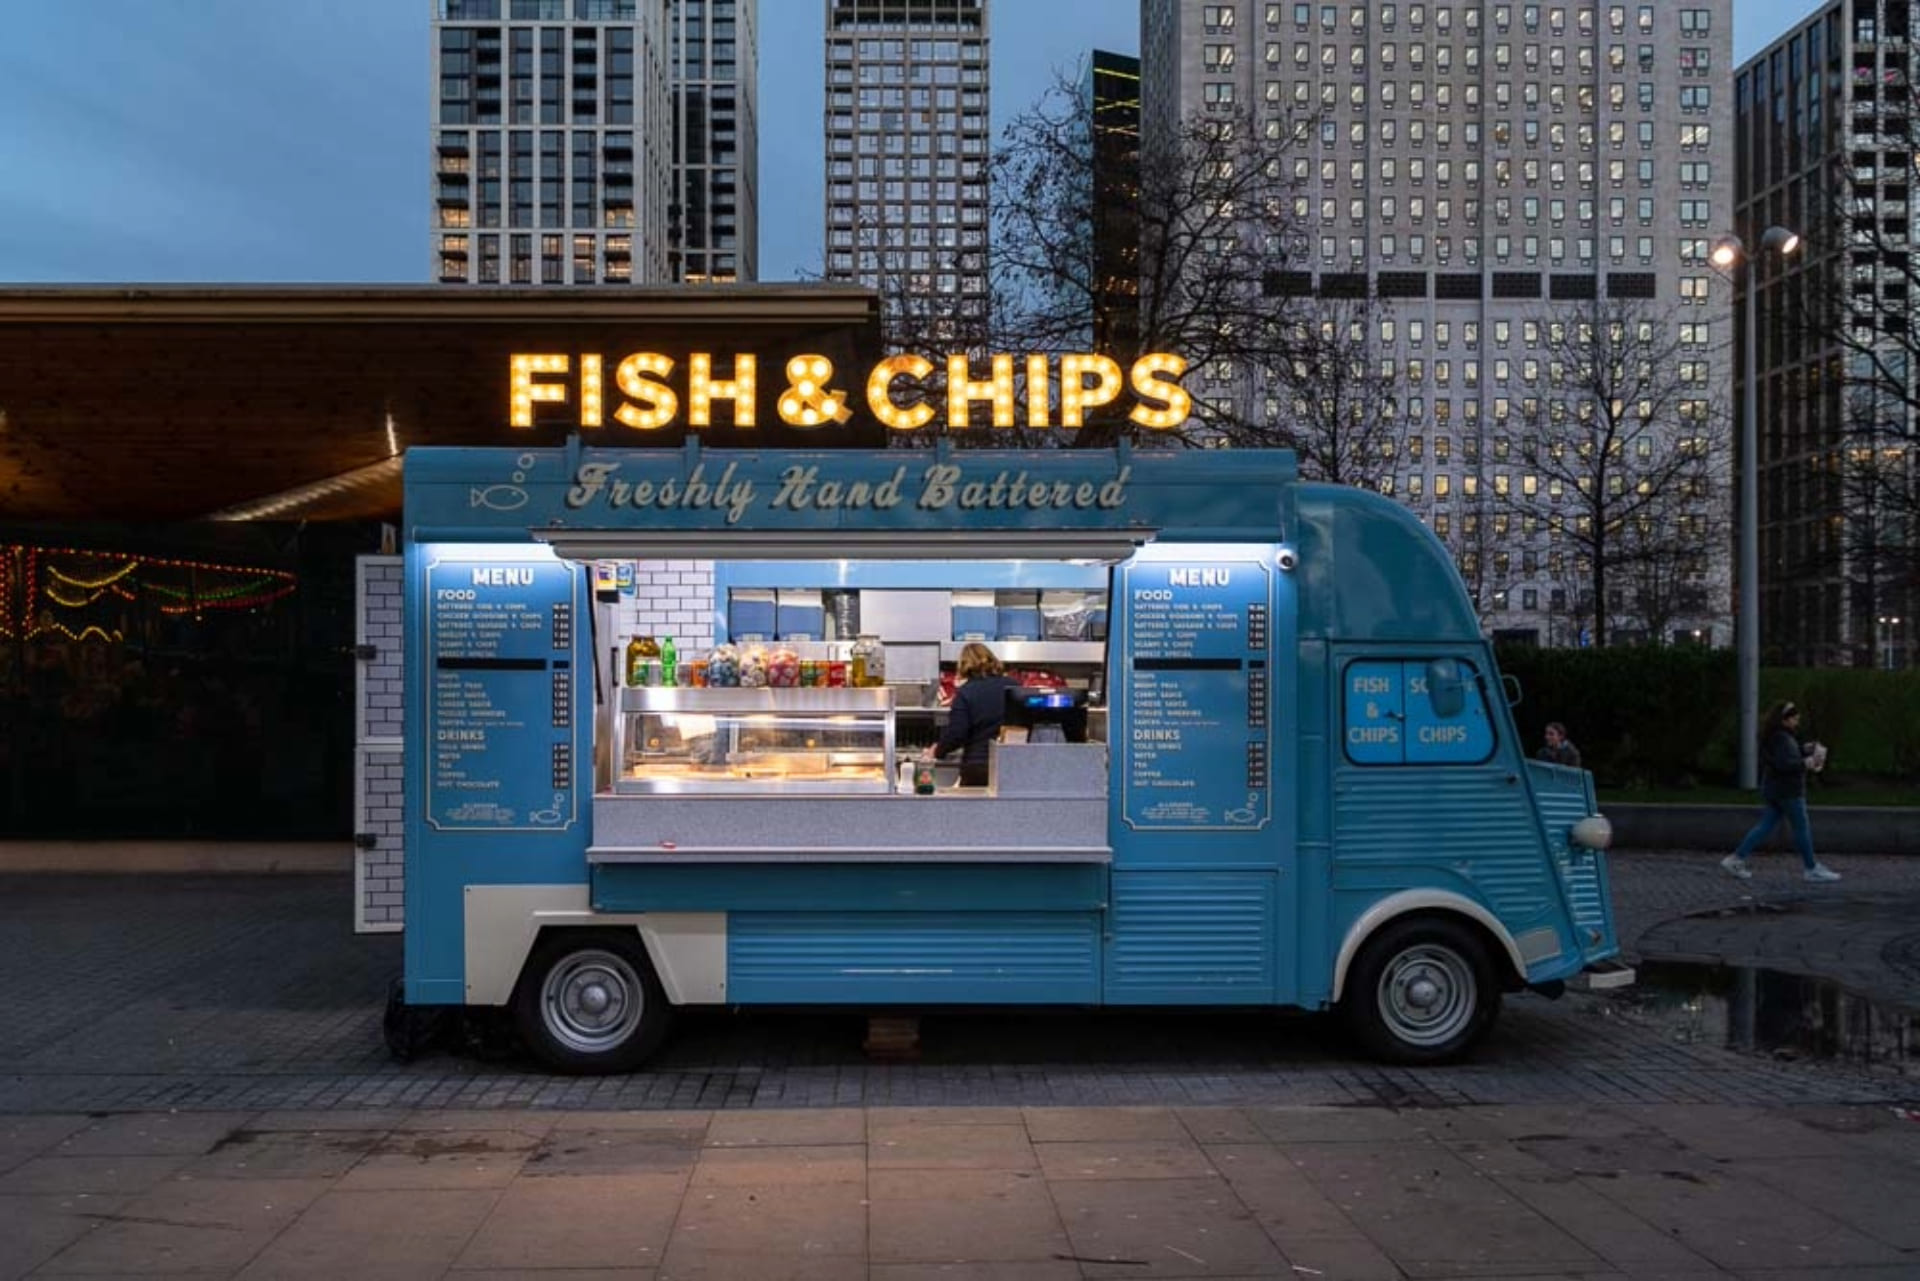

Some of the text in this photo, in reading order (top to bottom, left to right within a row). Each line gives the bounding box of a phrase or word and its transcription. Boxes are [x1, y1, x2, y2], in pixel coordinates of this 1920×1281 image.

[510, 352, 1192, 429] FISH & CHIPS
[567, 461, 1132, 525] Freshly Hand Battered
[472, 567, 534, 585] MENU
[1169, 567, 1231, 586] MENU
[437, 590, 476, 600] FOOD
[1134, 589, 1173, 600] FOOD
[1353, 677, 1389, 693] FISH
[1366, 702, 1379, 719] &
[437, 730, 485, 740] DRINKS
[1134, 729, 1180, 740] DRINKS
[1350, 726, 1399, 743] CHIPS
[1419, 726, 1467, 743] CHIPS
